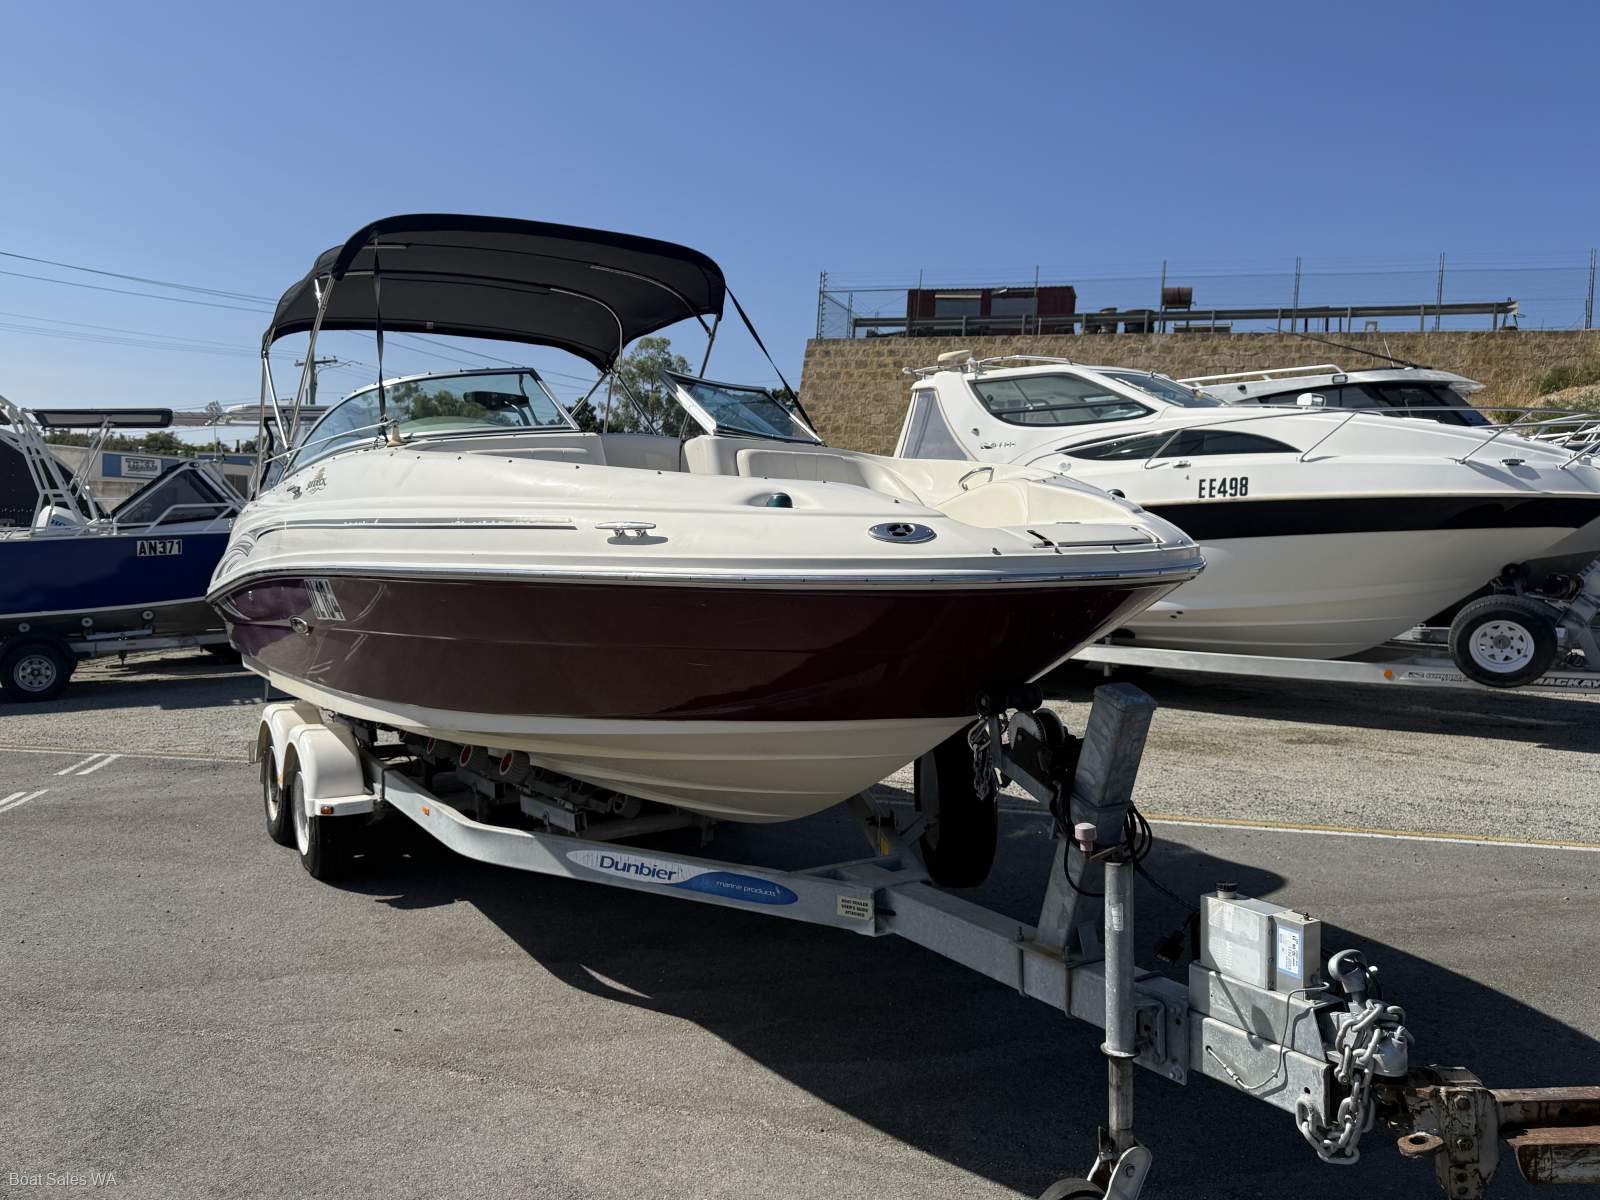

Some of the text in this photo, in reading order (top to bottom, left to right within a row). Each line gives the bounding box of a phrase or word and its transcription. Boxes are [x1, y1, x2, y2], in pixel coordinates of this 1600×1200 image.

[1198, 476, 1249, 499] EE498
[138, 540, 182, 556] AN371
[599, 855, 677, 881] Dunbier
[716, 880, 776, 897] marine products
